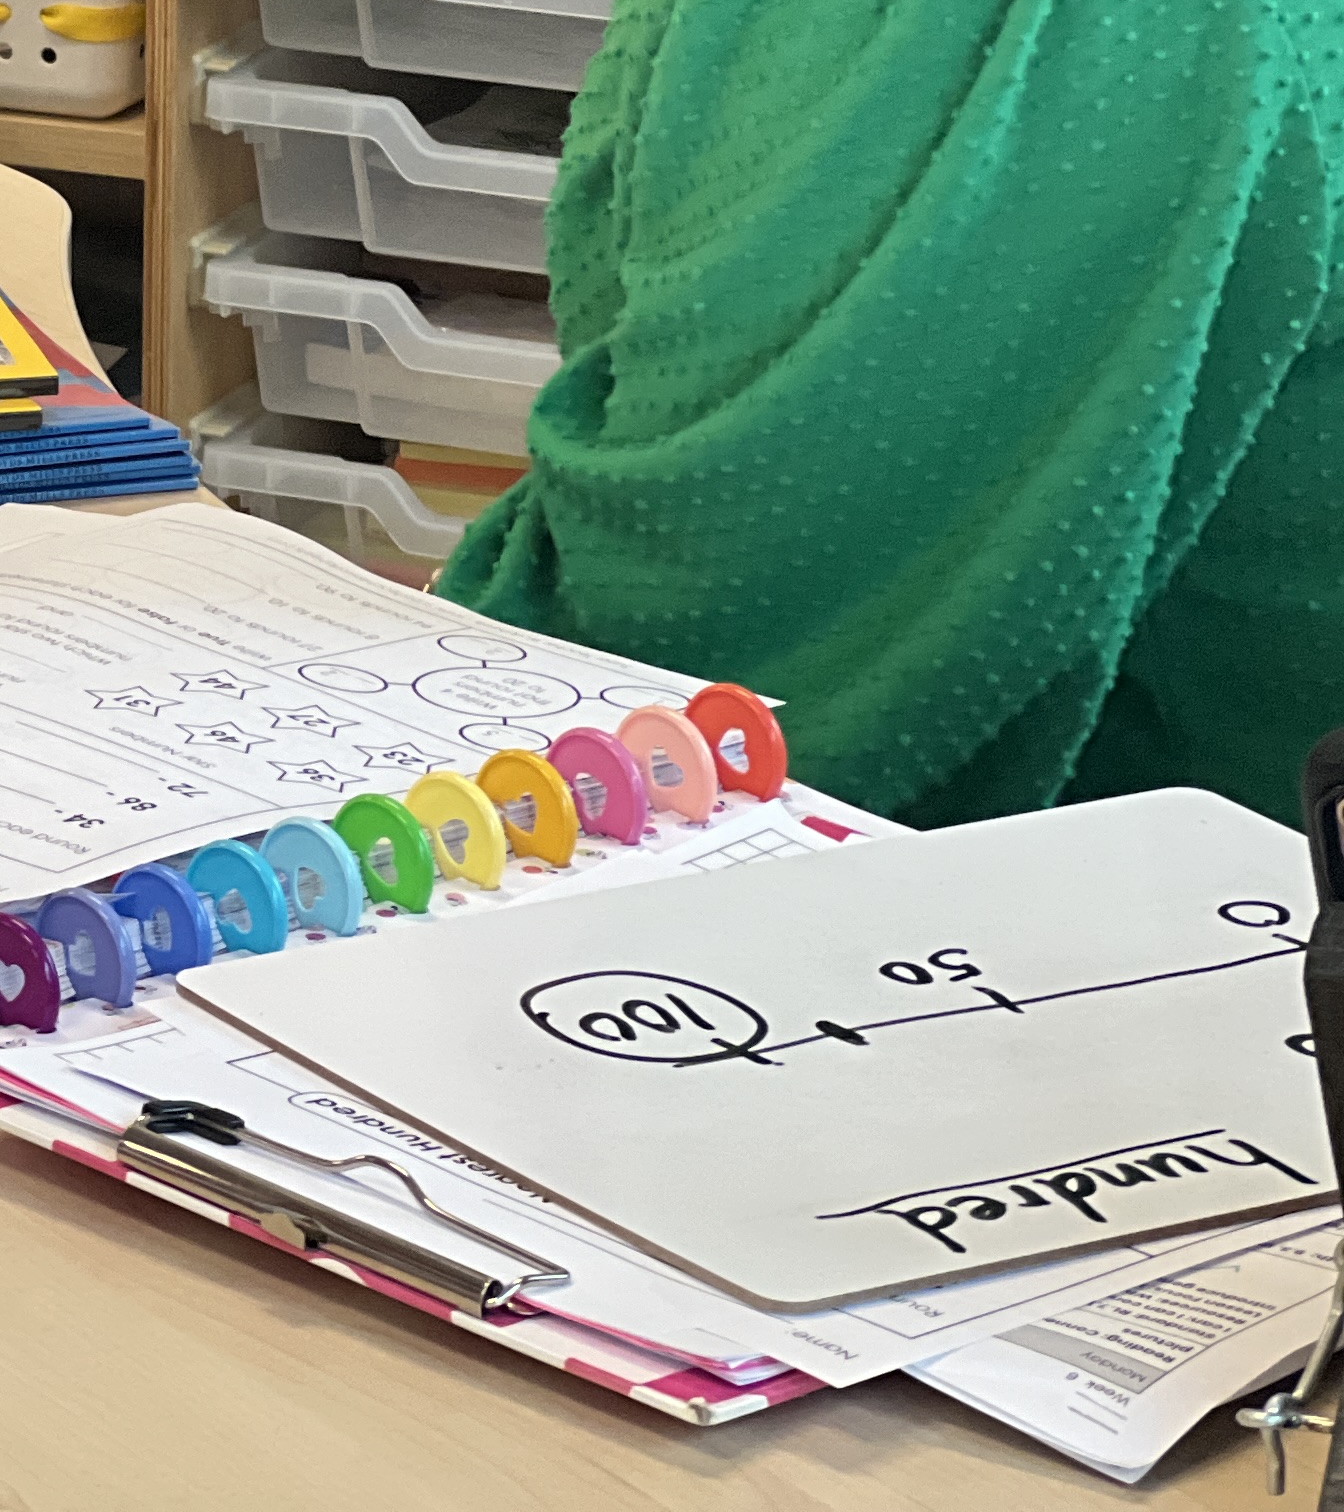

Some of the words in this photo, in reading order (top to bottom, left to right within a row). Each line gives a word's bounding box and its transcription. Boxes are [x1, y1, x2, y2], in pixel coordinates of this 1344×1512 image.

[115, 693, 152, 710] 31
[208, 728, 240, 745] 46
[383, 748, 423, 766] 23
[301, 766, 335, 783] 36
[33, 830, 91, 856] Round
[877, 947, 983, 987] 50
[577, 992, 718, 1043] 100
[304, 1096, 443, 1153] Hundred
[874, 1137, 1320, 1255] hundred
[1120, 1326, 1193, 1354] pictures
[1133, 1309, 1217, 1340] Standard:
[783, 1326, 859, 1361] Name:
[1103, 1332, 1177, 1364] Reading:
[1078, 1349, 1149, 1383] Monday
[1083, 1378, 1132, 1407] Week
